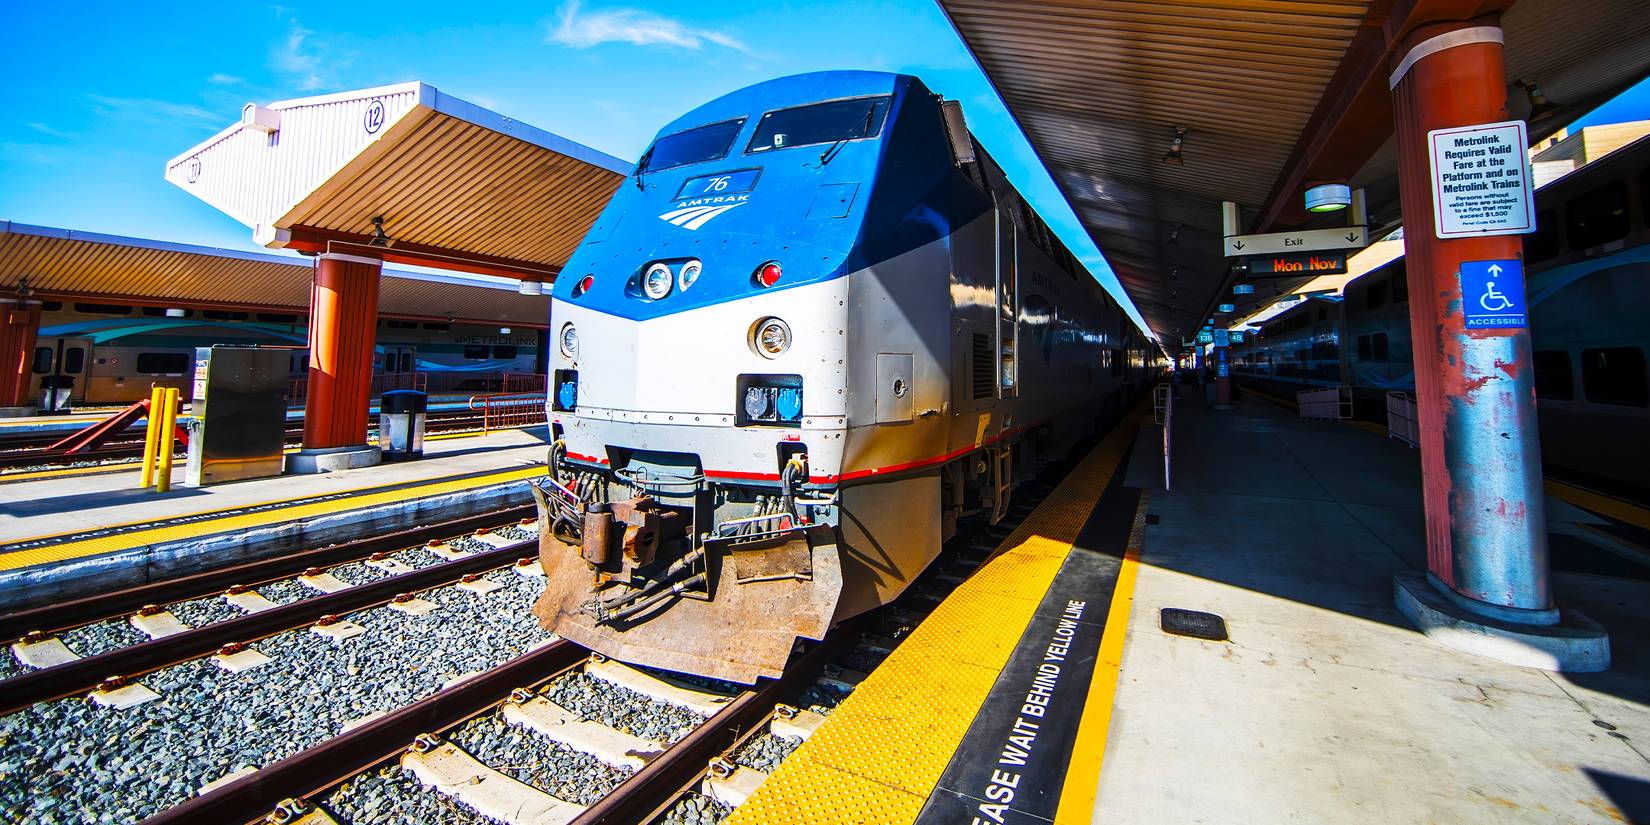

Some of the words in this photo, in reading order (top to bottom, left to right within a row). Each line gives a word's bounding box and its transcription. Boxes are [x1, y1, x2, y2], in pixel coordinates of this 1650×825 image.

[368, 106, 380, 128] 12
[1454, 135, 1500, 147] Metrolink
[1445, 148, 1486, 160] Requires
[1488, 144, 1512, 155] Valid
[1453, 161, 1474, 170] Fare
[1476, 159, 1487, 168] at
[1489, 157, 1505, 166] the
[1442, 171, 1483, 182] Platform
[1485, 168, 1503, 178] and
[1506, 168, 1518, 176] on
[703, 175, 732, 193] 76
[1443, 181, 1489, 193] Metrolink
[1491, 180, 1520, 189] Trains
[677, 194, 750, 209] AMTRAK
[1492, 197, 1518, 205] subject
[1284, 237, 1303, 246] Exit
[1273, 258, 1303, 272] Mon
[1309, 255, 1337, 271] Nov
[998, 716, 1041, 767] WAIT
[1020, 664, 1062, 719] BEHIND
[1043, 618, 1079, 668] YELLOW
[1063, 599, 1087, 621] LINE
